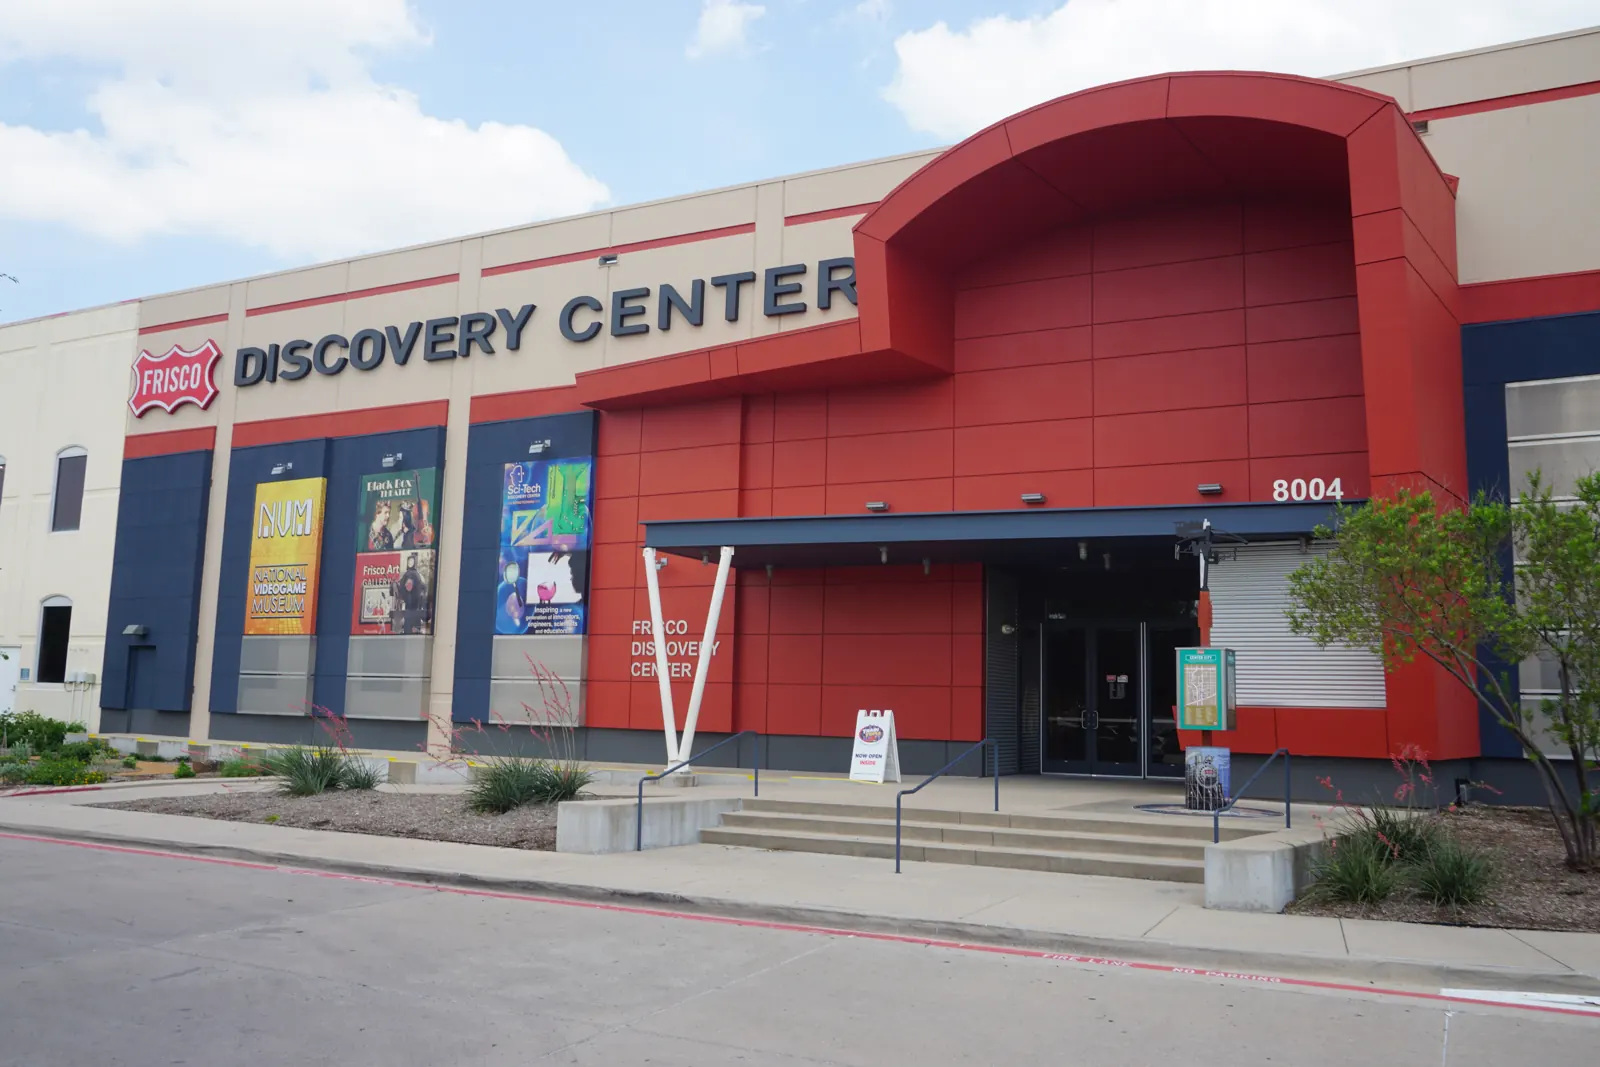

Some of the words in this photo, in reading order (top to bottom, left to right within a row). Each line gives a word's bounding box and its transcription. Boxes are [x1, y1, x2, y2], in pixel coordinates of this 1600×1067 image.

[234, 304, 536, 387] DISCOVERY
[559, 257, 858, 342] CENTER
[142, 362, 201, 395] FRISCO
[367, 480, 393, 491] Black
[395, 478, 412, 489] Box
[507, 483, 541, 494] Sci-Tech
[1273, 477, 1344, 501] 8004
[380, 488, 411, 498] THEATRE
[254, 566, 307, 583] NATIONAL
[363, 565, 386, 575] Frisco
[387, 564, 400, 574] Art
[254, 582, 307, 596] VIDEOGAME
[363, 578, 392, 586] GALLERY
[251, 595, 304, 614] MUSEUM
[534, 606, 558, 614] Inspiring
[632, 620, 688, 635] FRCO
[631, 640, 720, 656] DISOVEY
[631, 662, 692, 677] CENER
[1042, 952, 1080, 962] FIRE
[1088, 957, 1131, 967] LANE
[1172, 966, 1195, 974] NO
[1205, 970, 1280, 983] PARKING
